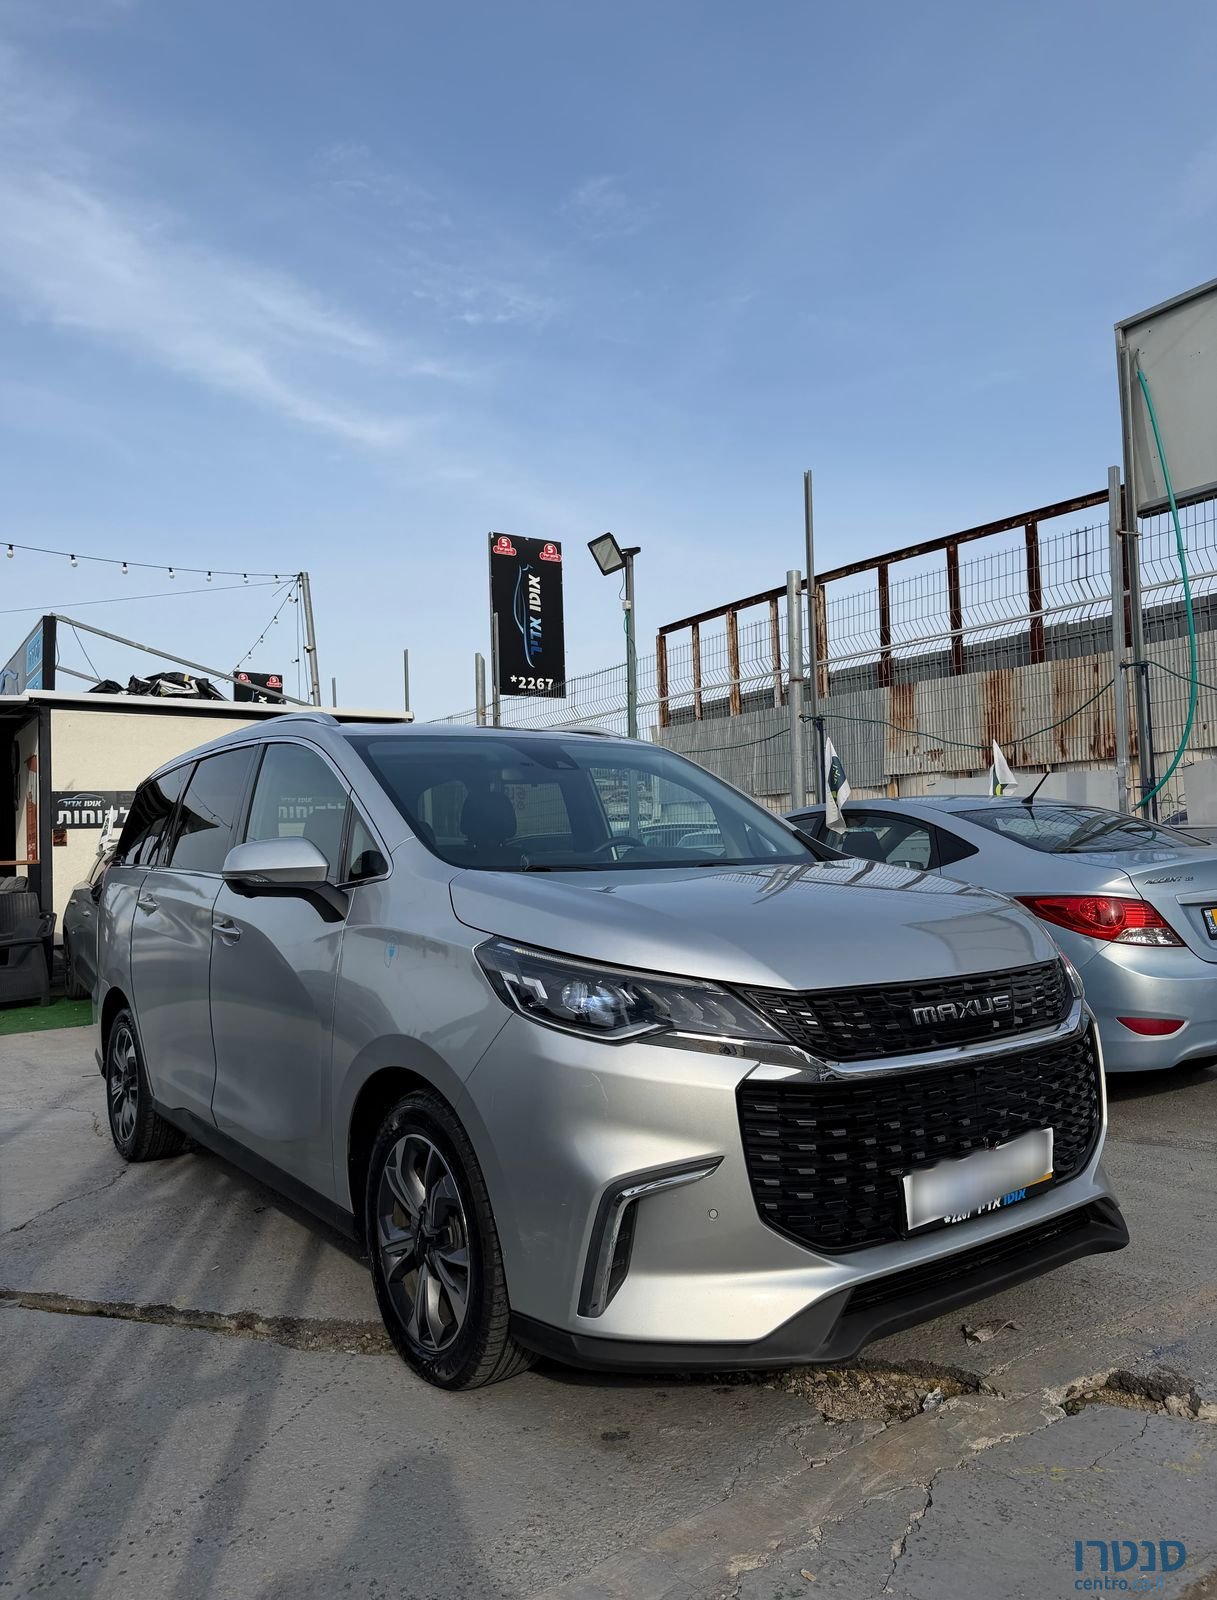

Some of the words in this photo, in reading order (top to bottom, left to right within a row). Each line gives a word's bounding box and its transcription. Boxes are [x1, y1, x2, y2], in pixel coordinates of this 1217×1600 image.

[502, 538, 508, 547] 5
[547, 545, 554, 554] 5
[528, 574, 542, 612] אוטו
[530, 616, 543, 655] אדיר
[912, 994, 1011, 1025] MAXUS
[1003, 1188, 1026, 1206] אוטו
